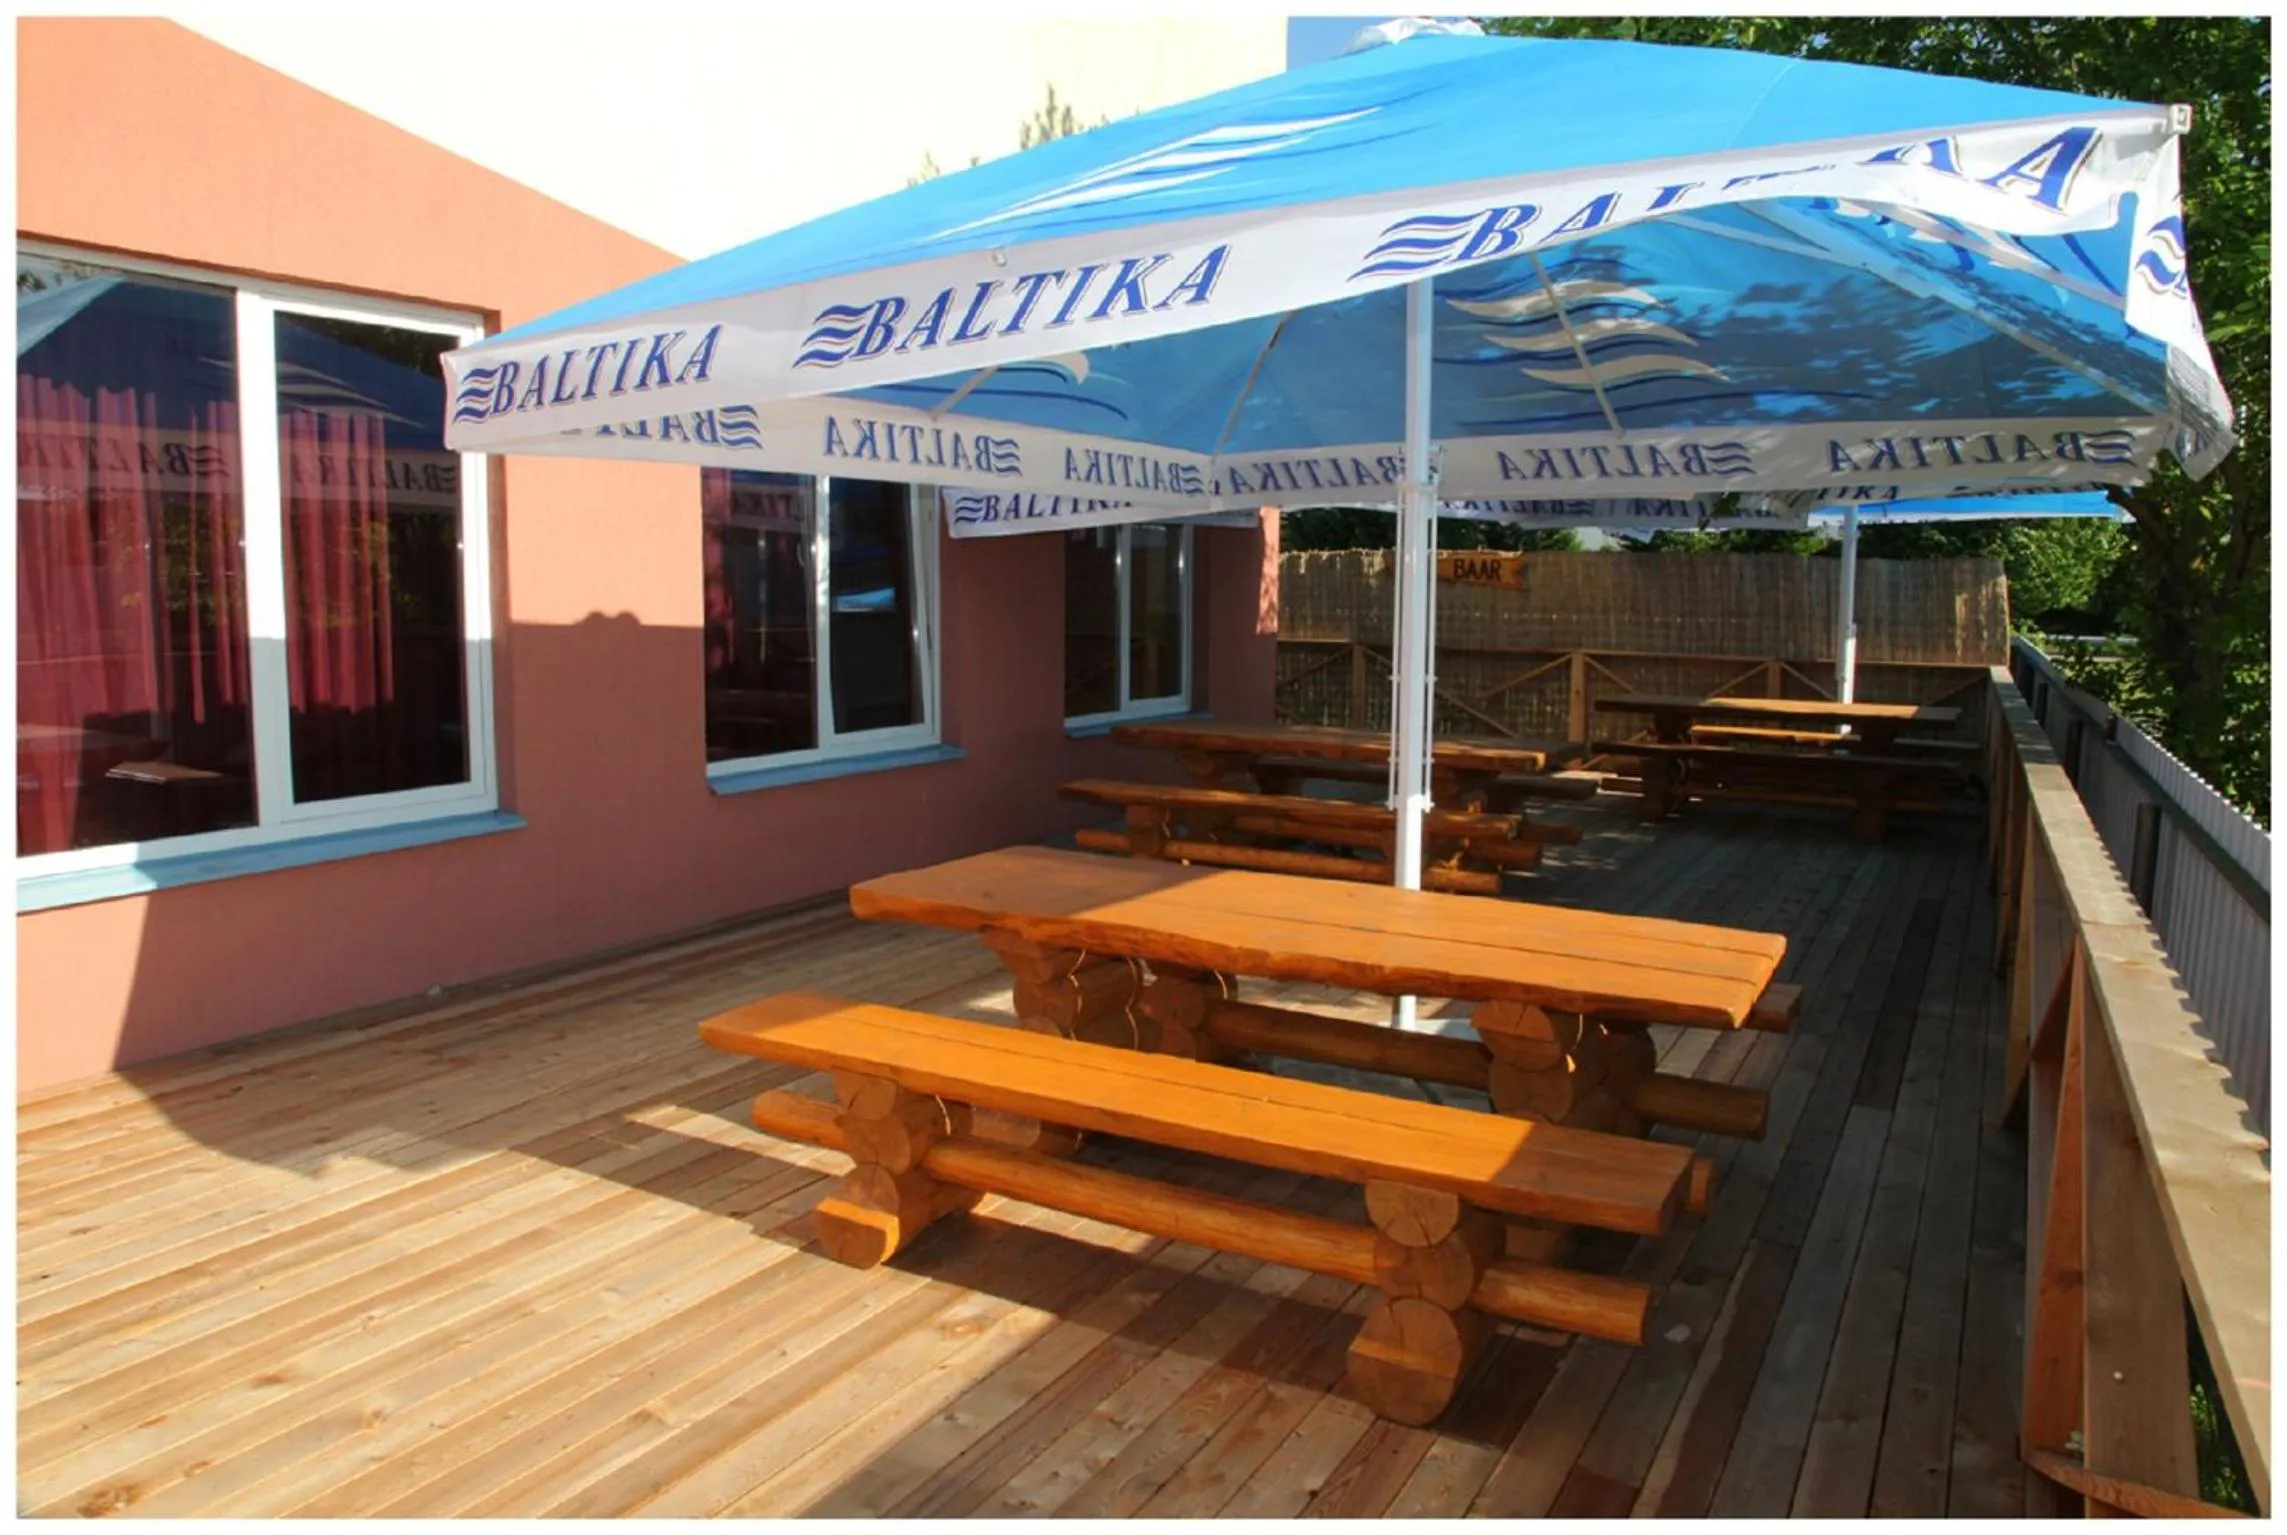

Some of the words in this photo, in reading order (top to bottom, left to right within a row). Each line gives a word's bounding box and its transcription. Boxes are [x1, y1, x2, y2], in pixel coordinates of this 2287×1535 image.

[847, 243, 1234, 362] BALTIKA
[491, 324, 723, 416] BALTIKA
[1453, 559, 1501, 581] BAAR
